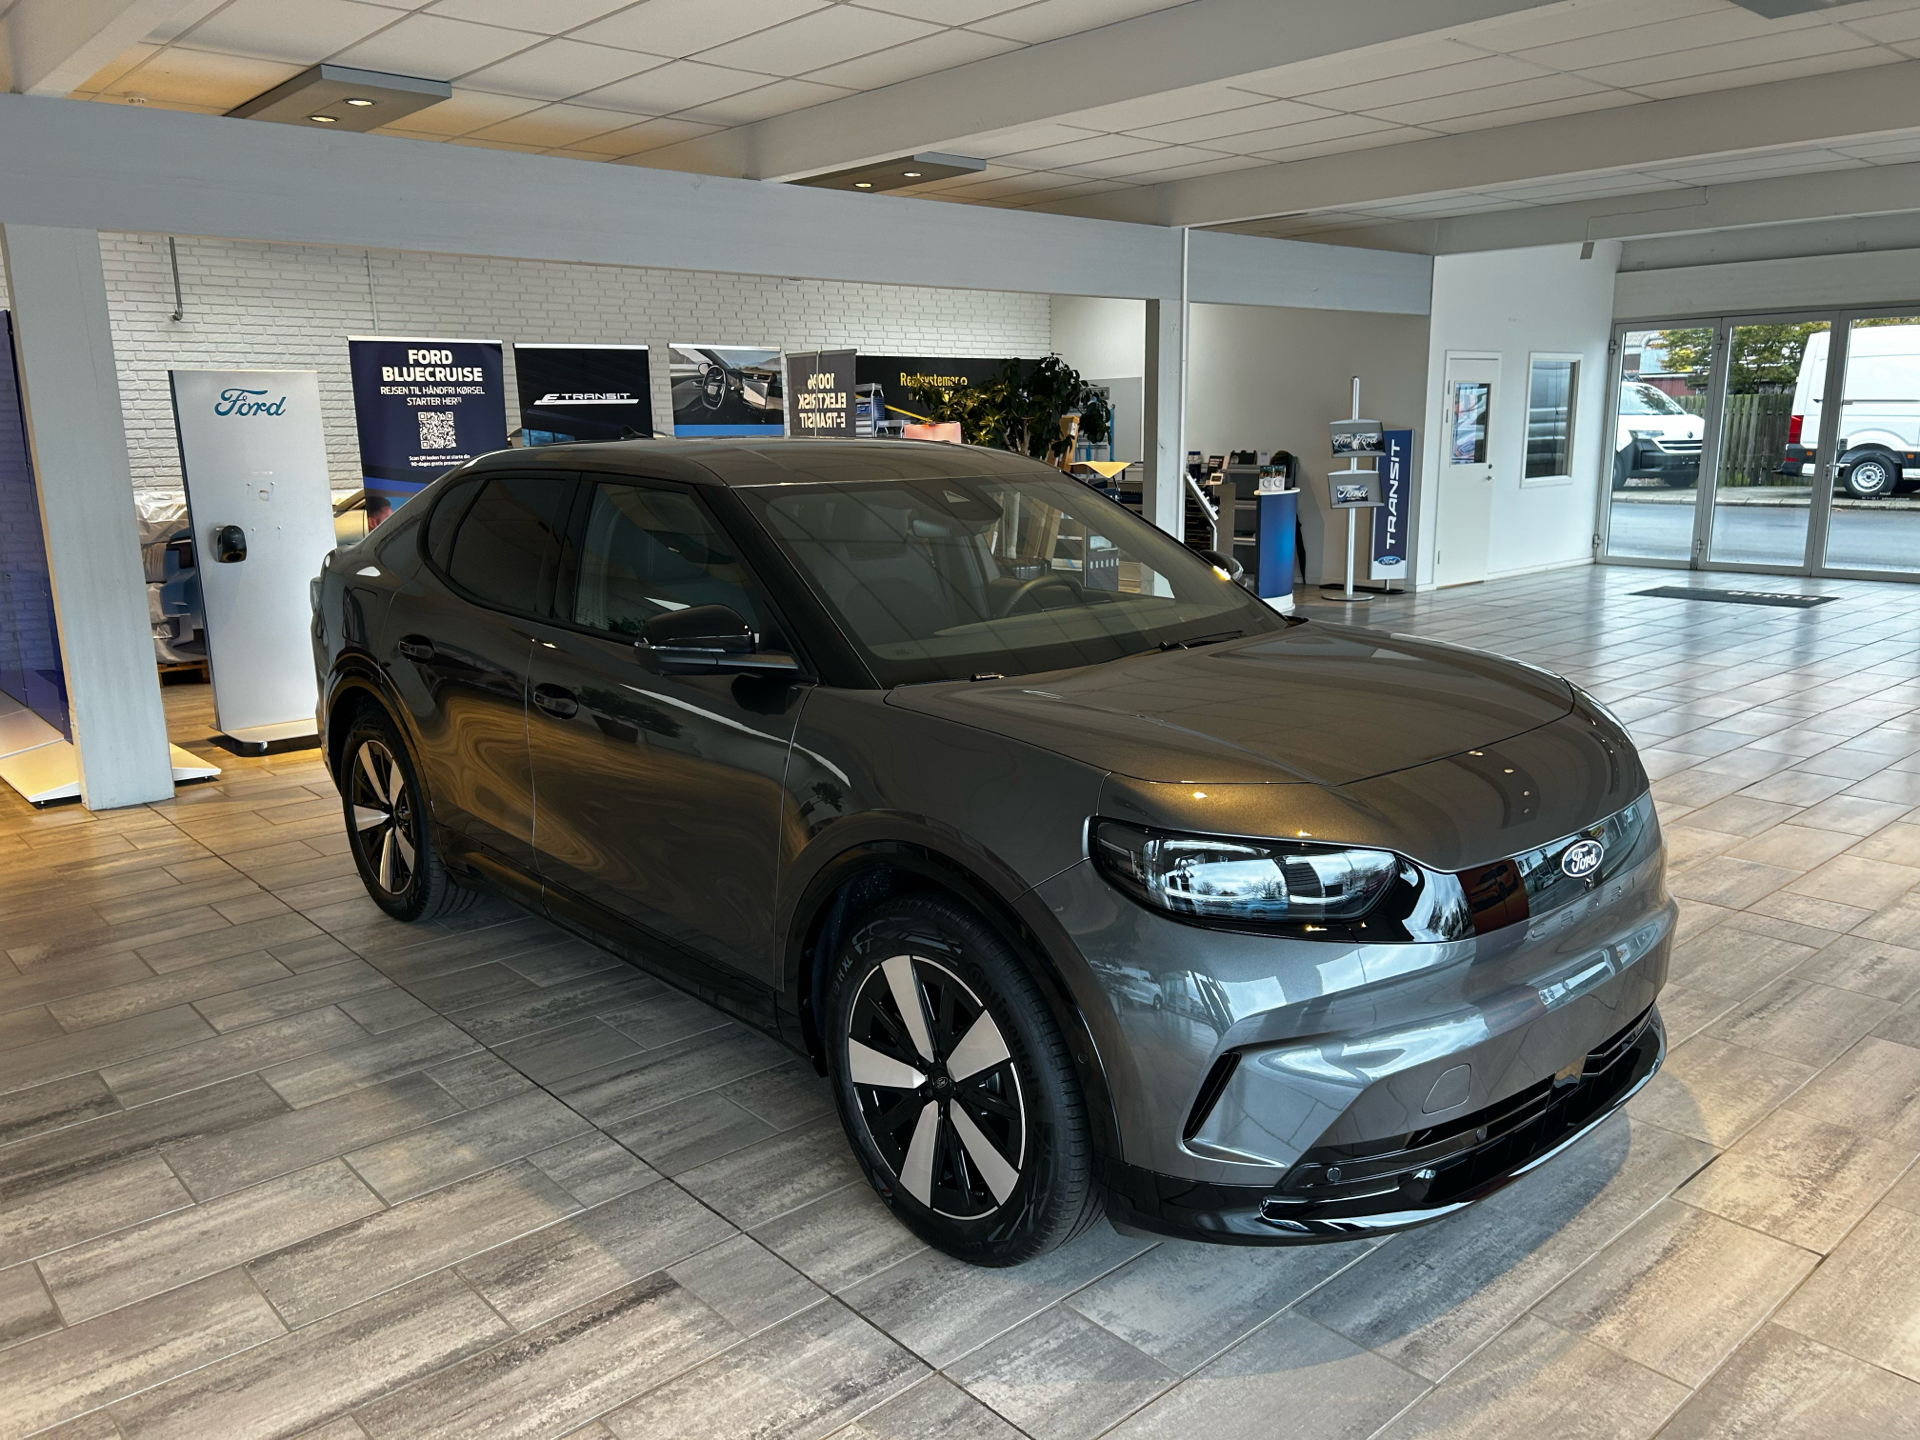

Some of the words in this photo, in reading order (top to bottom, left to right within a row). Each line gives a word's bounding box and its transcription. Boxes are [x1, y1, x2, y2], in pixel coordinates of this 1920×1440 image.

[408, 349, 453, 364] FORD
[382, 366, 483, 381] BLUECRUISE
[380, 386, 409, 395] REJSEN
[410, 386, 421, 395] TIL
[422, 384, 456, 395] HÅNDFRI
[456, 386, 485, 395] KØRSEL
[561, 392, 631, 400] TRANSIT
[213, 387, 287, 416] Ford
[406, 397, 441, 406] STARTER
[1337, 484, 1369, 498] Ford
[1386, 438, 1400, 550] TRANSIT
[1571, 844, 1597, 873] Ford
[1530, 876, 1635, 942] CAPRI
[966, 961, 1041, 1085] Continental
